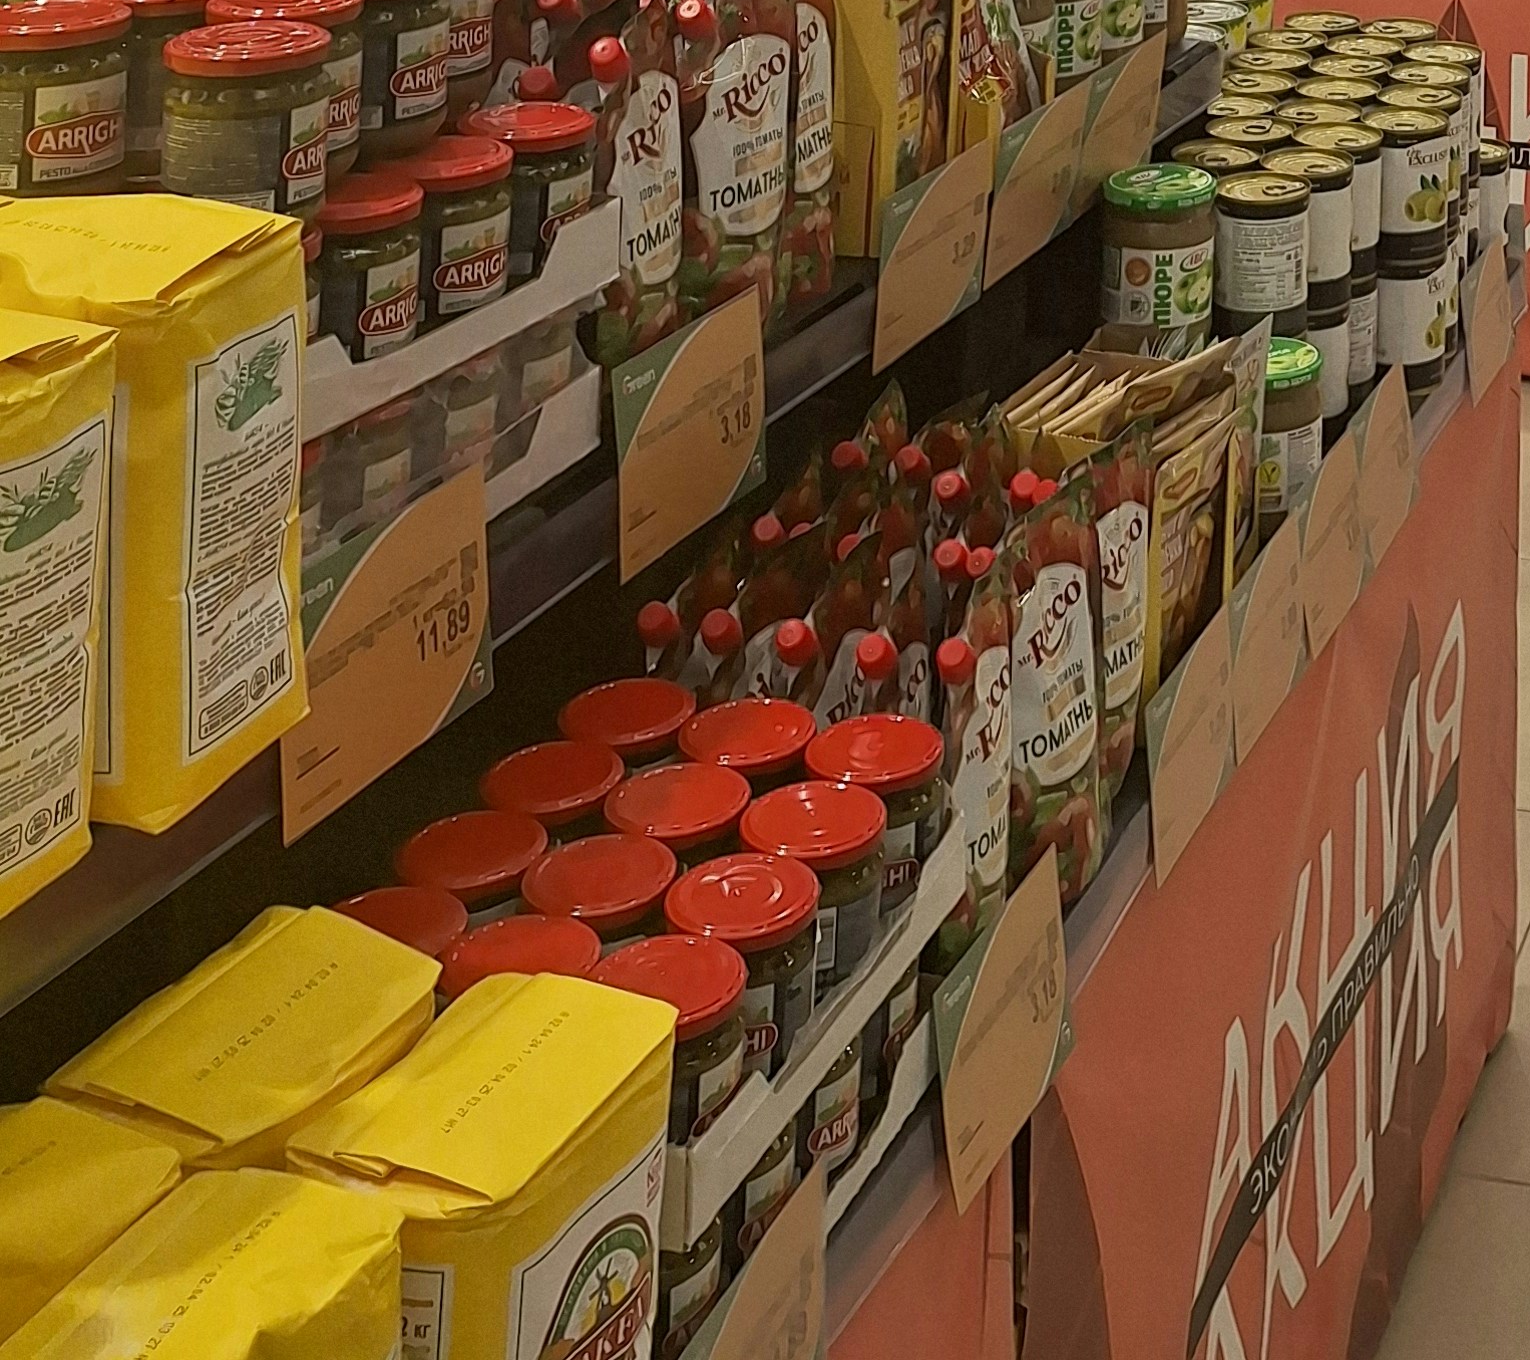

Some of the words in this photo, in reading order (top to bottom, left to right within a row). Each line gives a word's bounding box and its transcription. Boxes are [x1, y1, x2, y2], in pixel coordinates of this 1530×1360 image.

[450, 22, 492, 55] RRIGH
[1056, 3, 1075, 74] ПЮРЕ
[400, 59, 447, 93] ARRIG
[721, 52, 787, 124] Ricco
[329, 92, 361, 128] RRIG
[36, 116, 125, 155] ARRIGH
[709, 168, 785, 212] ТОМАТН
[443, 250, 507, 287] ARRIGH
[1153, 252, 1174, 330] ПЮРЕ
[368, 290, 418, 330] ARRIG
[719, 400, 751, 446] 3,18
[301, 577, 335, 608] reen
[416, 600, 471, 663] 11,89
[1027, 579, 1082, 671] Ricco
[1018, 698, 1094, 765] ТОМАТН
[1328, 853, 1421, 1044] ПРАВИЛЬНО
